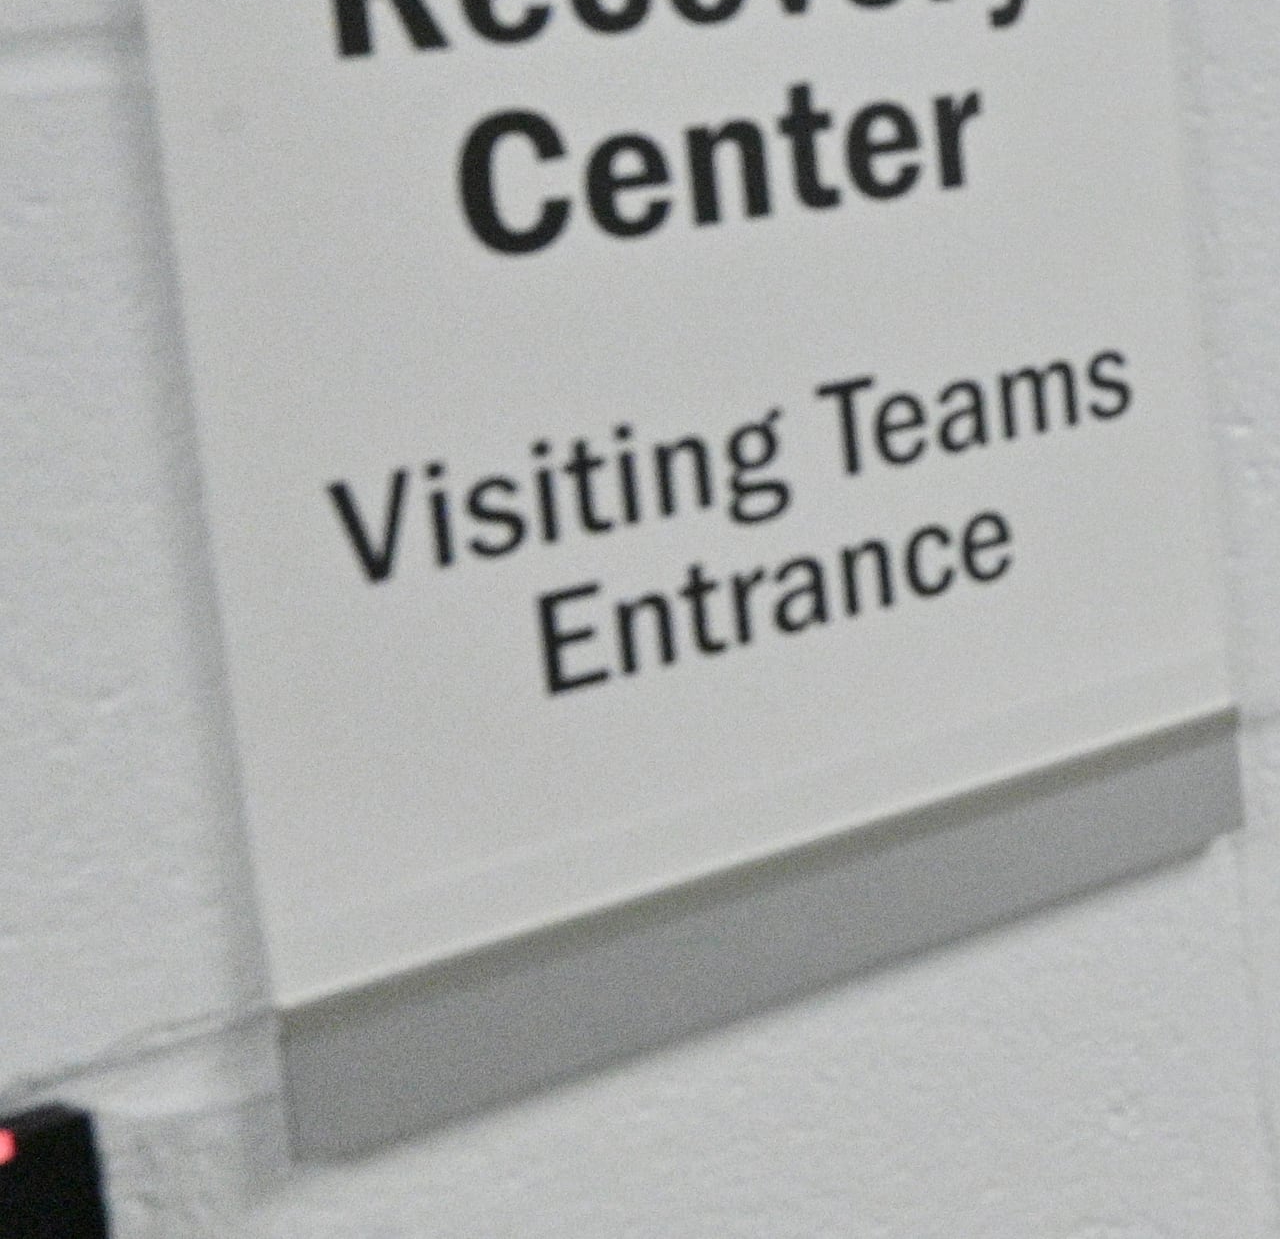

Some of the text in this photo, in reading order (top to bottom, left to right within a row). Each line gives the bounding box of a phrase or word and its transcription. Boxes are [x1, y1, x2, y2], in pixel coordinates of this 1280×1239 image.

[456, 82, 983, 258] Center
[326, 350, 1133, 585] Visiting Teams
[536, 511, 1013, 698] Entrance
